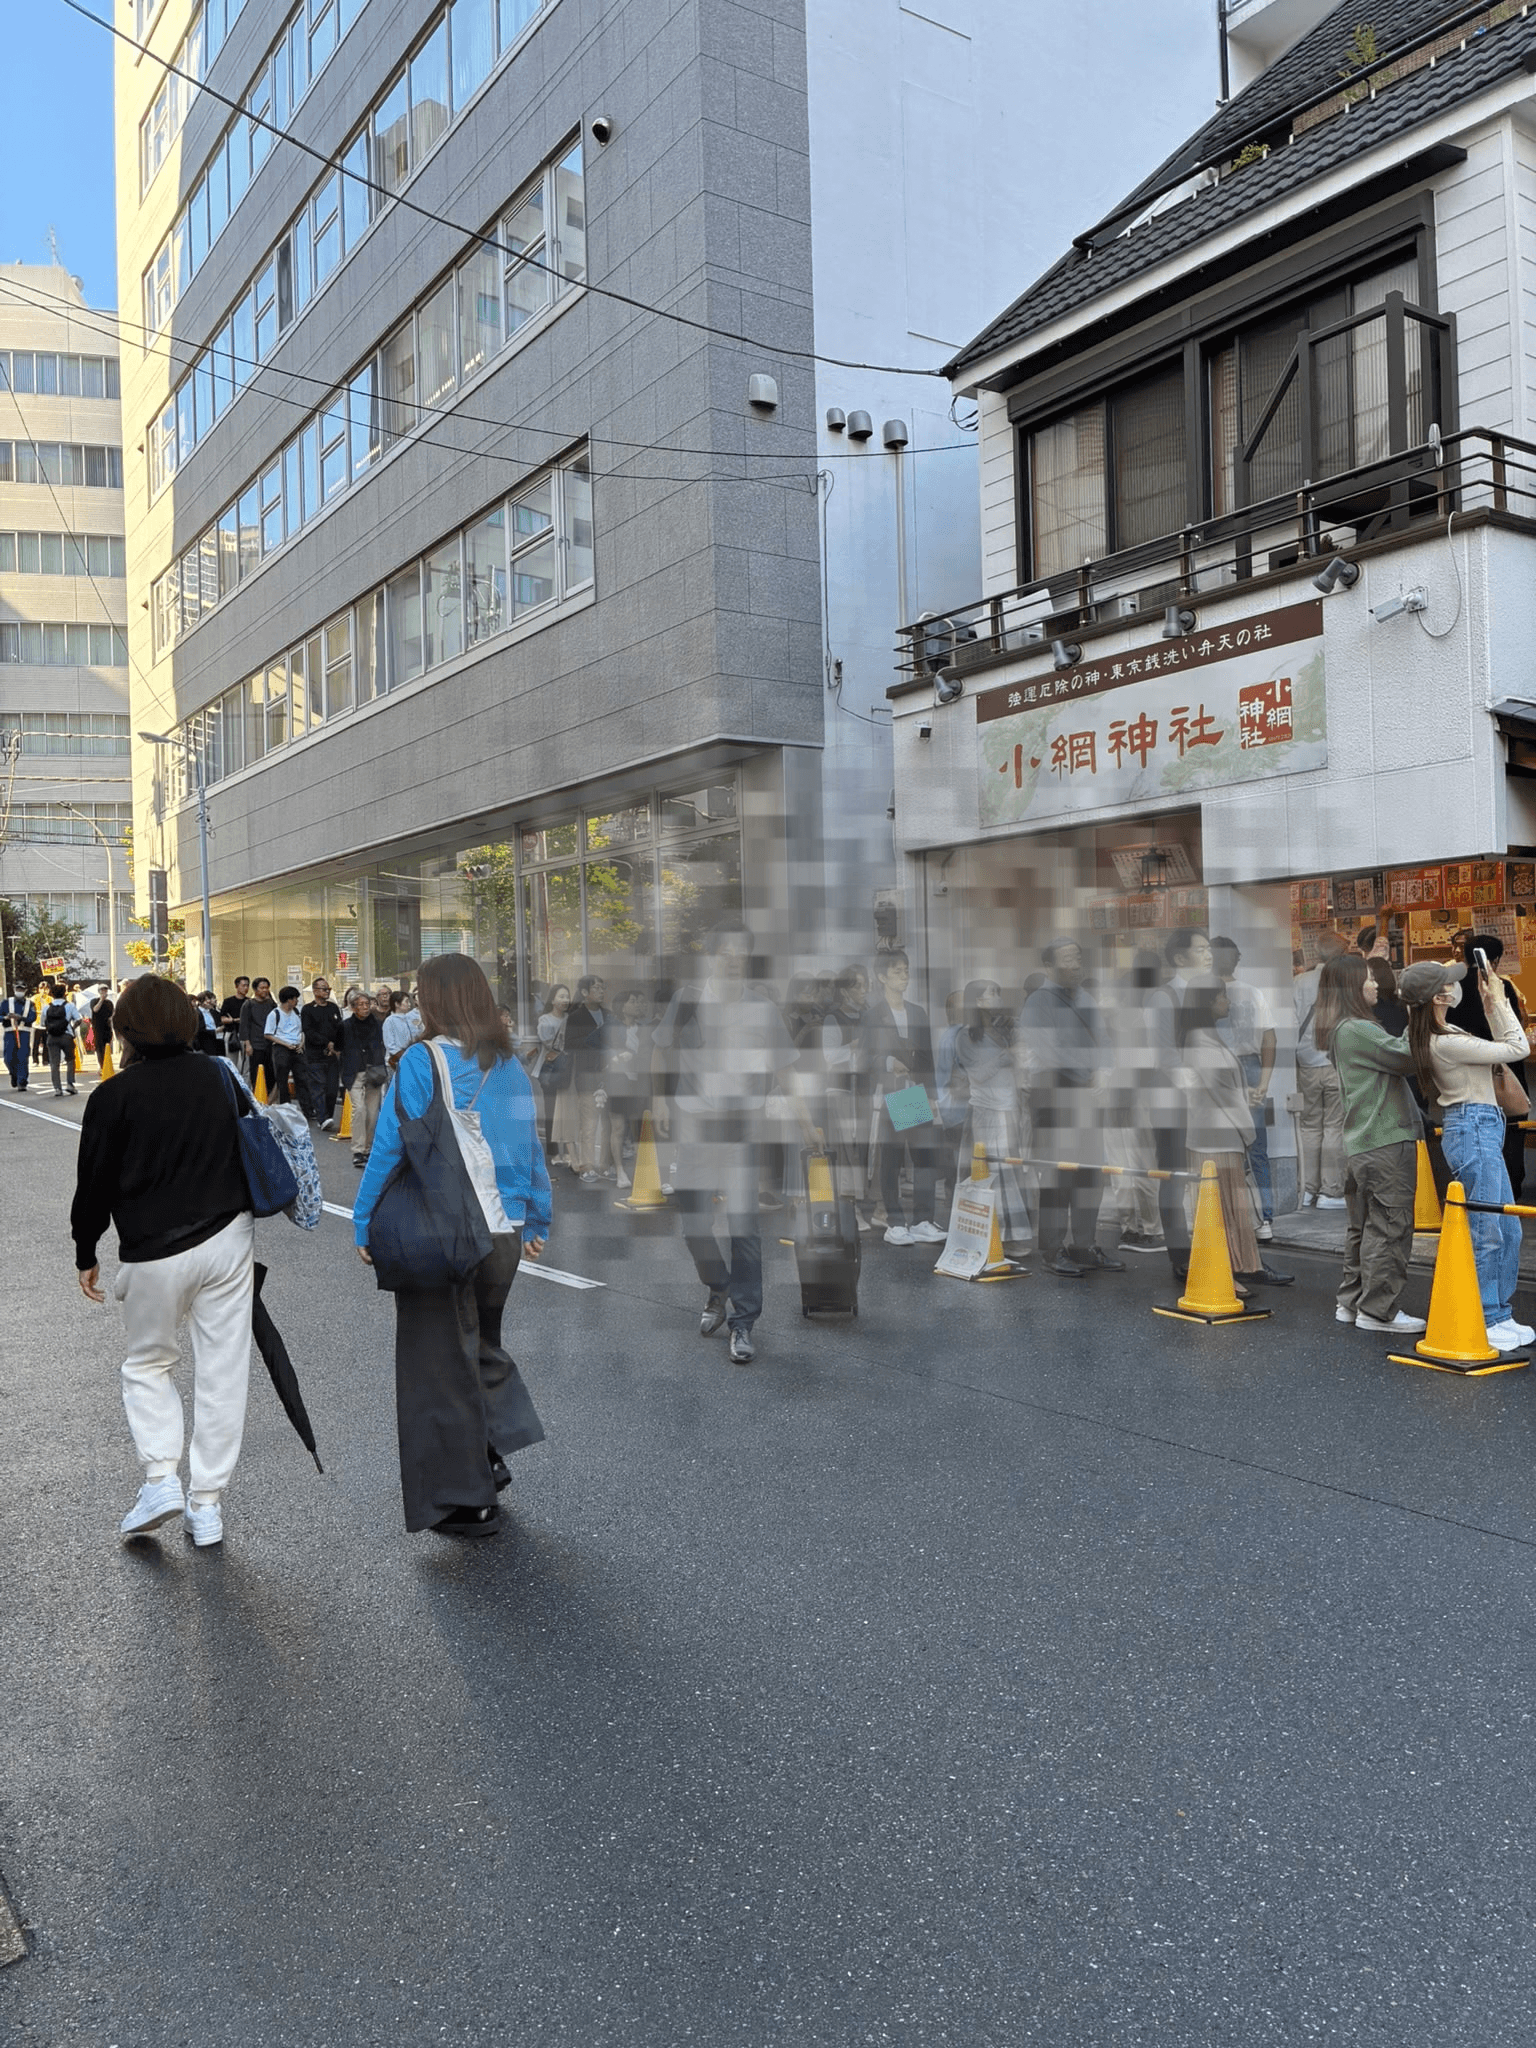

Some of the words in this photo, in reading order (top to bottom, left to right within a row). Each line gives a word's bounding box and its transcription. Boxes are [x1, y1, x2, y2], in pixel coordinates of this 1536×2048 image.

[1240, 697, 1266, 749] 神社
[1266, 679, 1291, 731] 小網
[999, 703, 1224, 789] 小網神社
